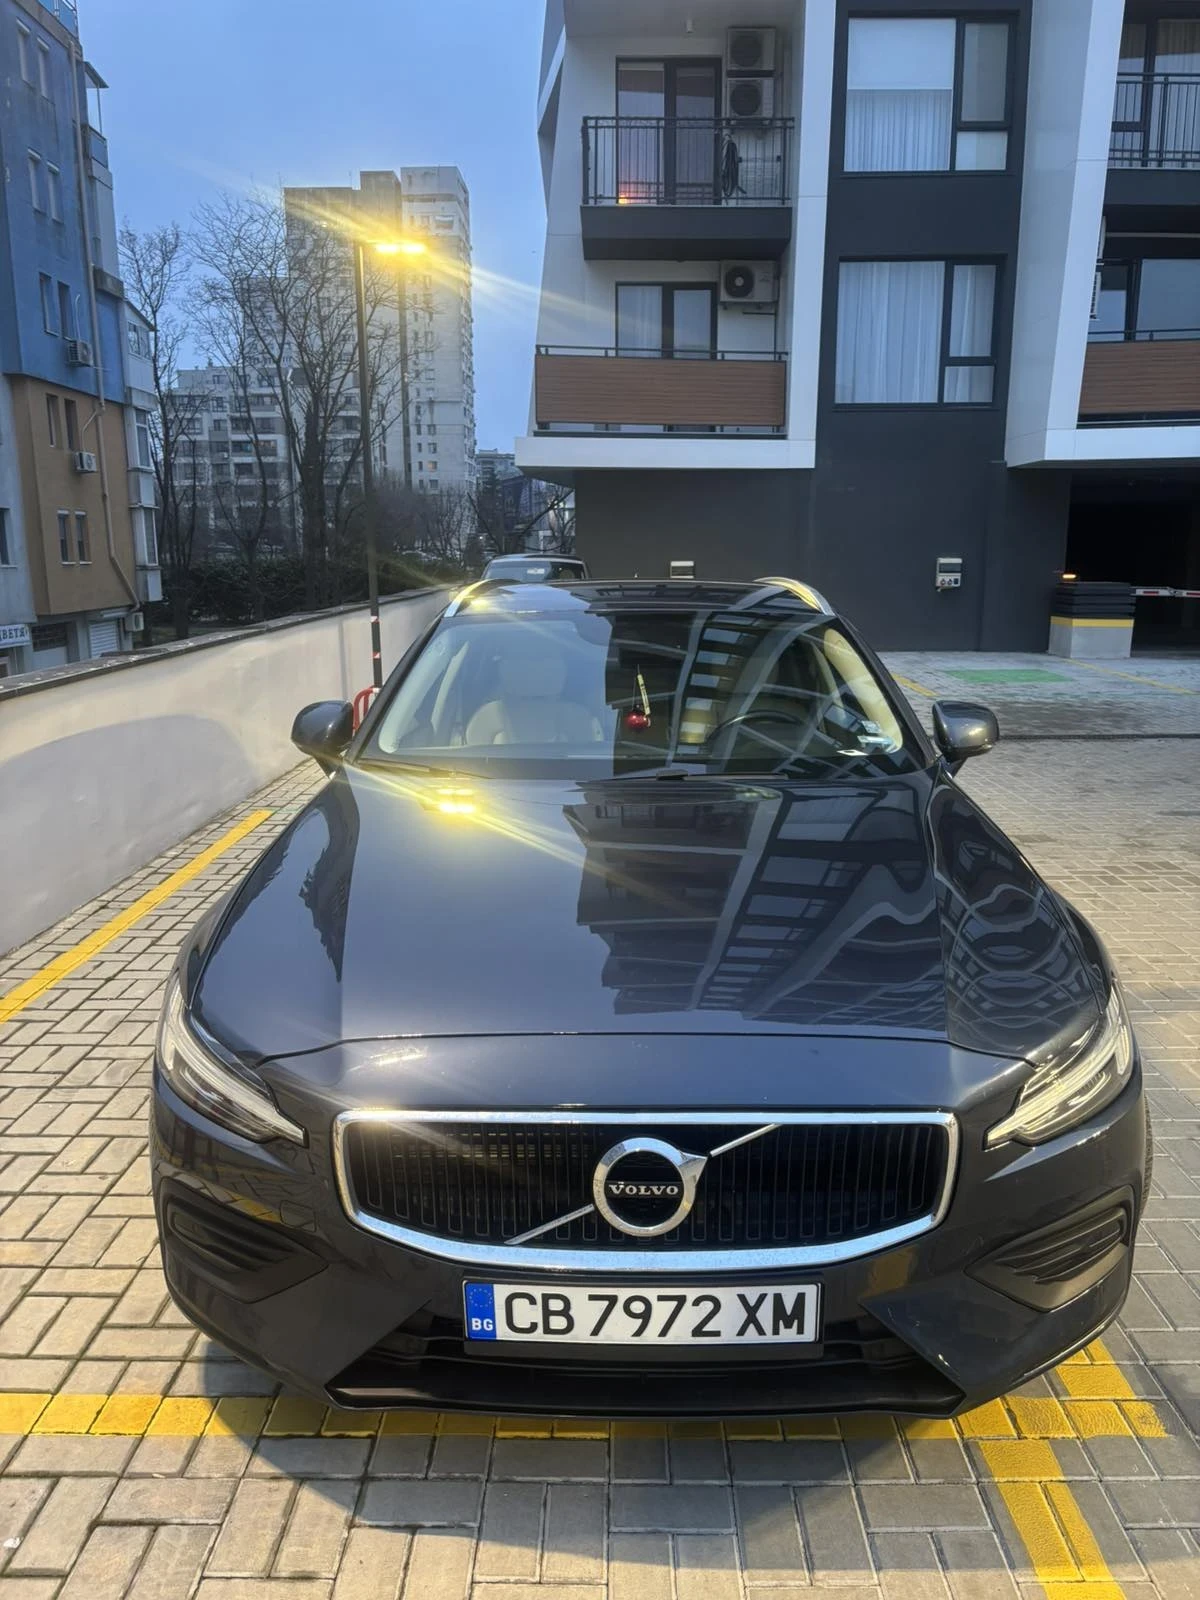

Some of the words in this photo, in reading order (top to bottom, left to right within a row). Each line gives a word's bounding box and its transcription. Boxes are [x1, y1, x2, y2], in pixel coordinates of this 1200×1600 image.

[608, 1184, 679, 1195] VOLVO
[504, 1292, 575, 1336] CB
[587, 1294, 722, 1337] 7972
[735, 1292, 807, 1337] XM
[471, 1317, 493, 1331] BG
